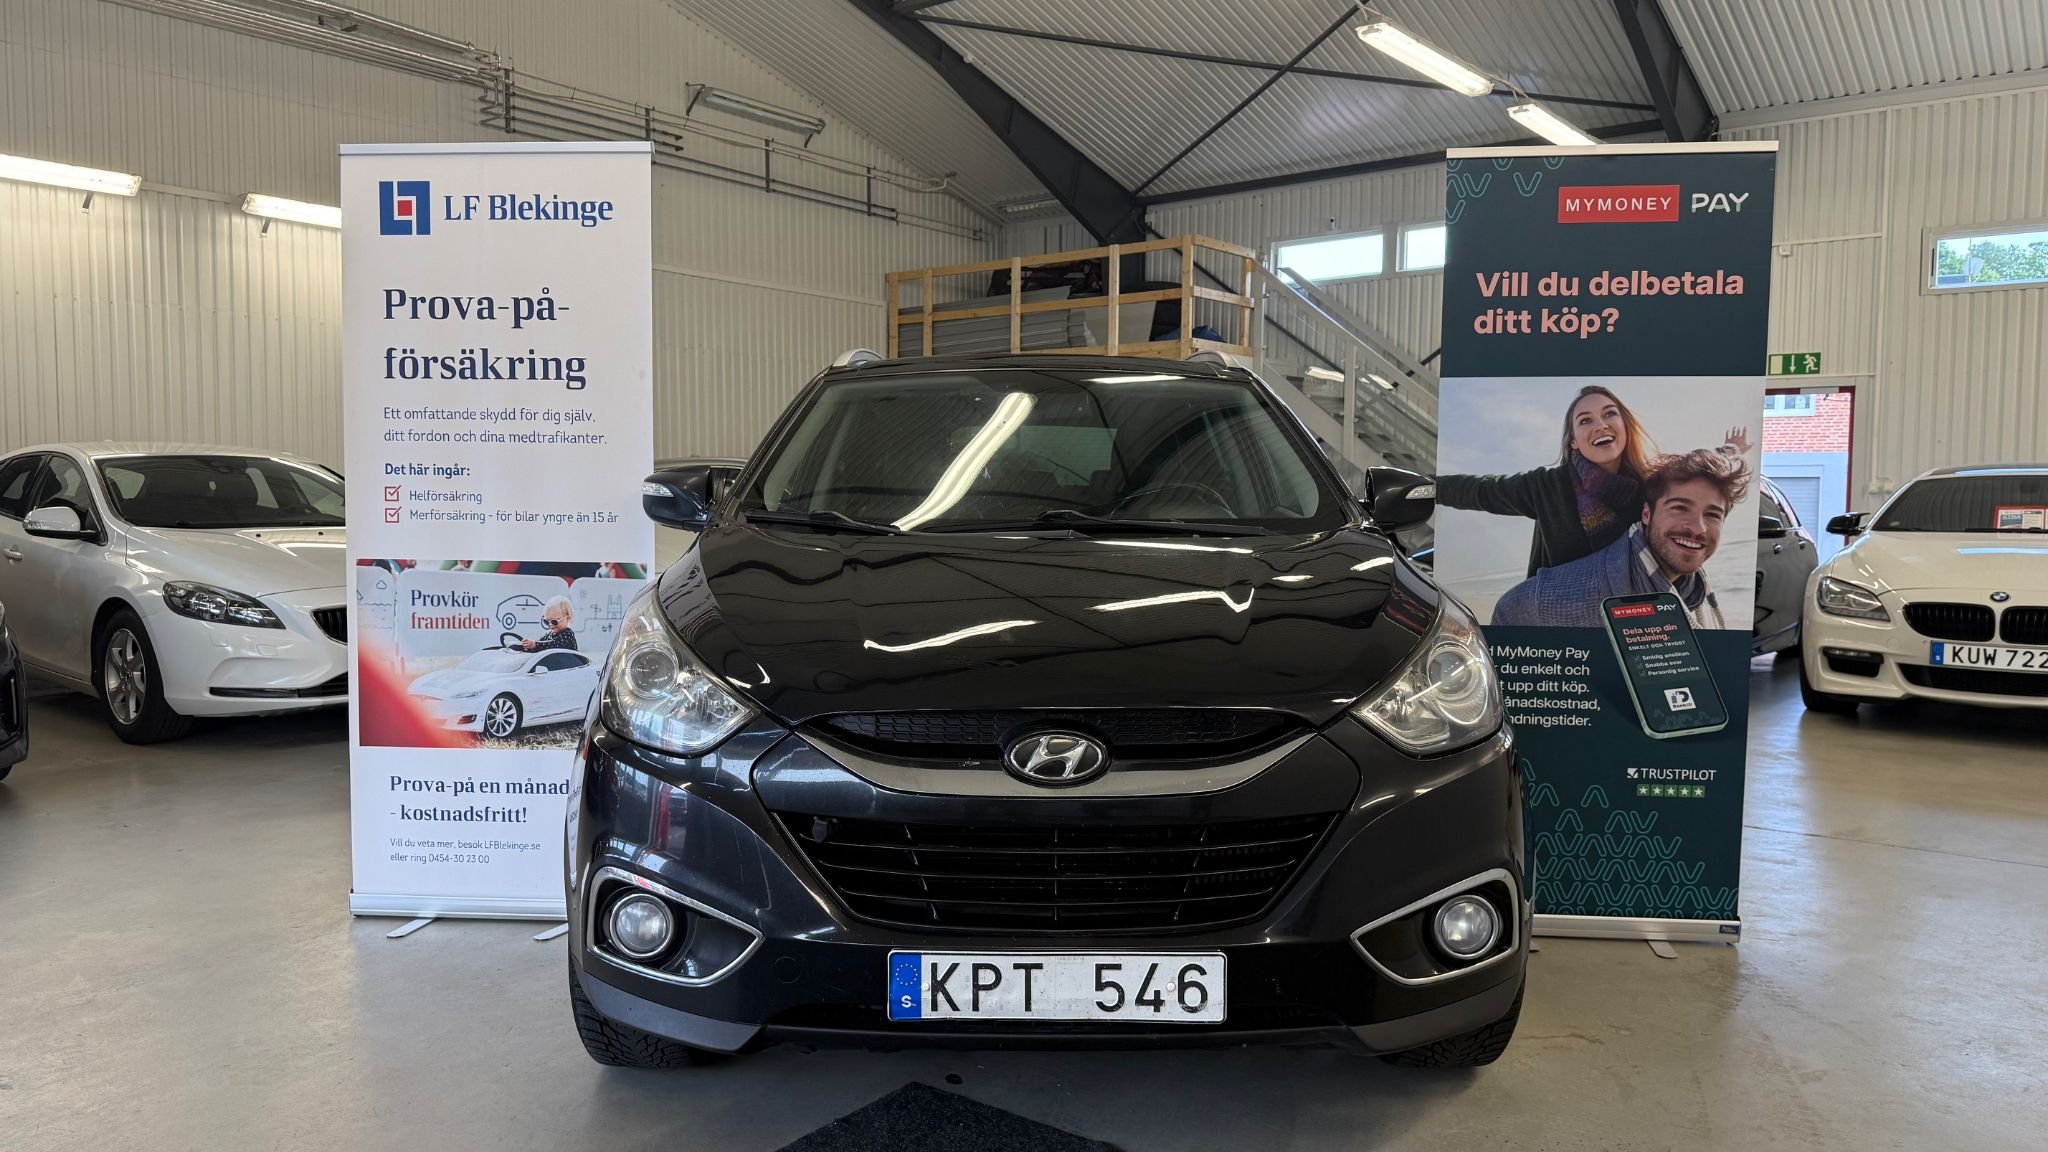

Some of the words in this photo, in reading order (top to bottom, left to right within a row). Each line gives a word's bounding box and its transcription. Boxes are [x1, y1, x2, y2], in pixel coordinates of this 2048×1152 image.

[443, 195, 480, 220] LF
[488, 194, 613, 227] Blekinge
[1565, 197, 1672, 212] MYMONEY
[1691, 192, 1749, 213] PAY
[1476, 271, 1528, 297] Vill
[1537, 271, 1579, 296] du
[1588, 269, 1745, 296] delbetala
[383, 287, 570, 329] Prova-på-
[1474, 308, 1531, 334] ditt
[1541, 306, 1620, 339] köp?
[384, 348, 588, 390] försäkring
[384, 407, 401, 420] Ett
[404, 407, 477, 420] omfattande
[479, 408, 516, 424] skydd
[520, 408, 538, 421] för
[542, 408, 561, 424] dig
[384, 430, 405, 442] ditt
[408, 430, 450, 442] fordon
[453, 430, 476, 442] och
[479, 430, 505, 443] dina
[509, 430, 607, 445] medtrafikanter.
[384, 463, 406, 476] Det
[409, 463, 430, 476] här
[433, 463, 470, 479] ingår:
[409, 490, 482, 505] Helförsäkring
[410, 509, 486, 524] Merförsäkring
[496, 510, 512, 522] för
[515, 511, 540, 523] bilar
[543, 513, 574, 525] yngre
[576, 512, 590, 523] än
[593, 512, 605, 523] 15
[607, 511, 619, 523] år
[411, 589, 479, 608] Provkör
[1614, 606, 1653, 616] MYMONEY
[1656, 603, 1677, 612] PAY
[411, 612, 490, 630] framtiden
[1622, 628, 1643, 636] Dela
[1644, 626, 1662, 634] upp
[1663, 624, 1678, 632] din
[1625, 633, 1671, 644] betalning.
[1497, 645, 1562, 660] MyMoney
[1566, 647, 1590, 661] Pay
[1952, 646, 1997, 666] KUW
[2005, 649, 2048, 669] 722
[1501, 663, 1518, 674] du
[1521, 663, 1562, 675] enkelt
[1565, 664, 1590, 676] och
[1507, 682, 1534, 694] upp
[1536, 680, 1559, 692] ditt
[1562, 681, 1590, 695] köp.
[1504, 696, 1601, 711] ånadskostnad,
[1640, 767, 1717, 781] TRUSTPILOT
[390, 775, 475, 797] Prova-på
[479, 781, 501, 794] en
[506, 777, 570, 795] månad
[400, 804, 527, 823] kostnadsfritt!
[390, 838, 403, 847] Vill
[404, 838, 415, 848] du
[417, 840, 435, 848] veta
[484, 840, 541, 852] LFBlekinge.se
[390, 853, 408, 862] eller
[410, 853, 427, 864] ring
[429, 854, 465, 863] 0454-30
[466, 854, 477, 863] 23
[478, 855, 490, 863] 00
[930, 962, 1043, 1012] KPT
[1094, 962, 1209, 1014] 546
[901, 995, 912, 1008] S
